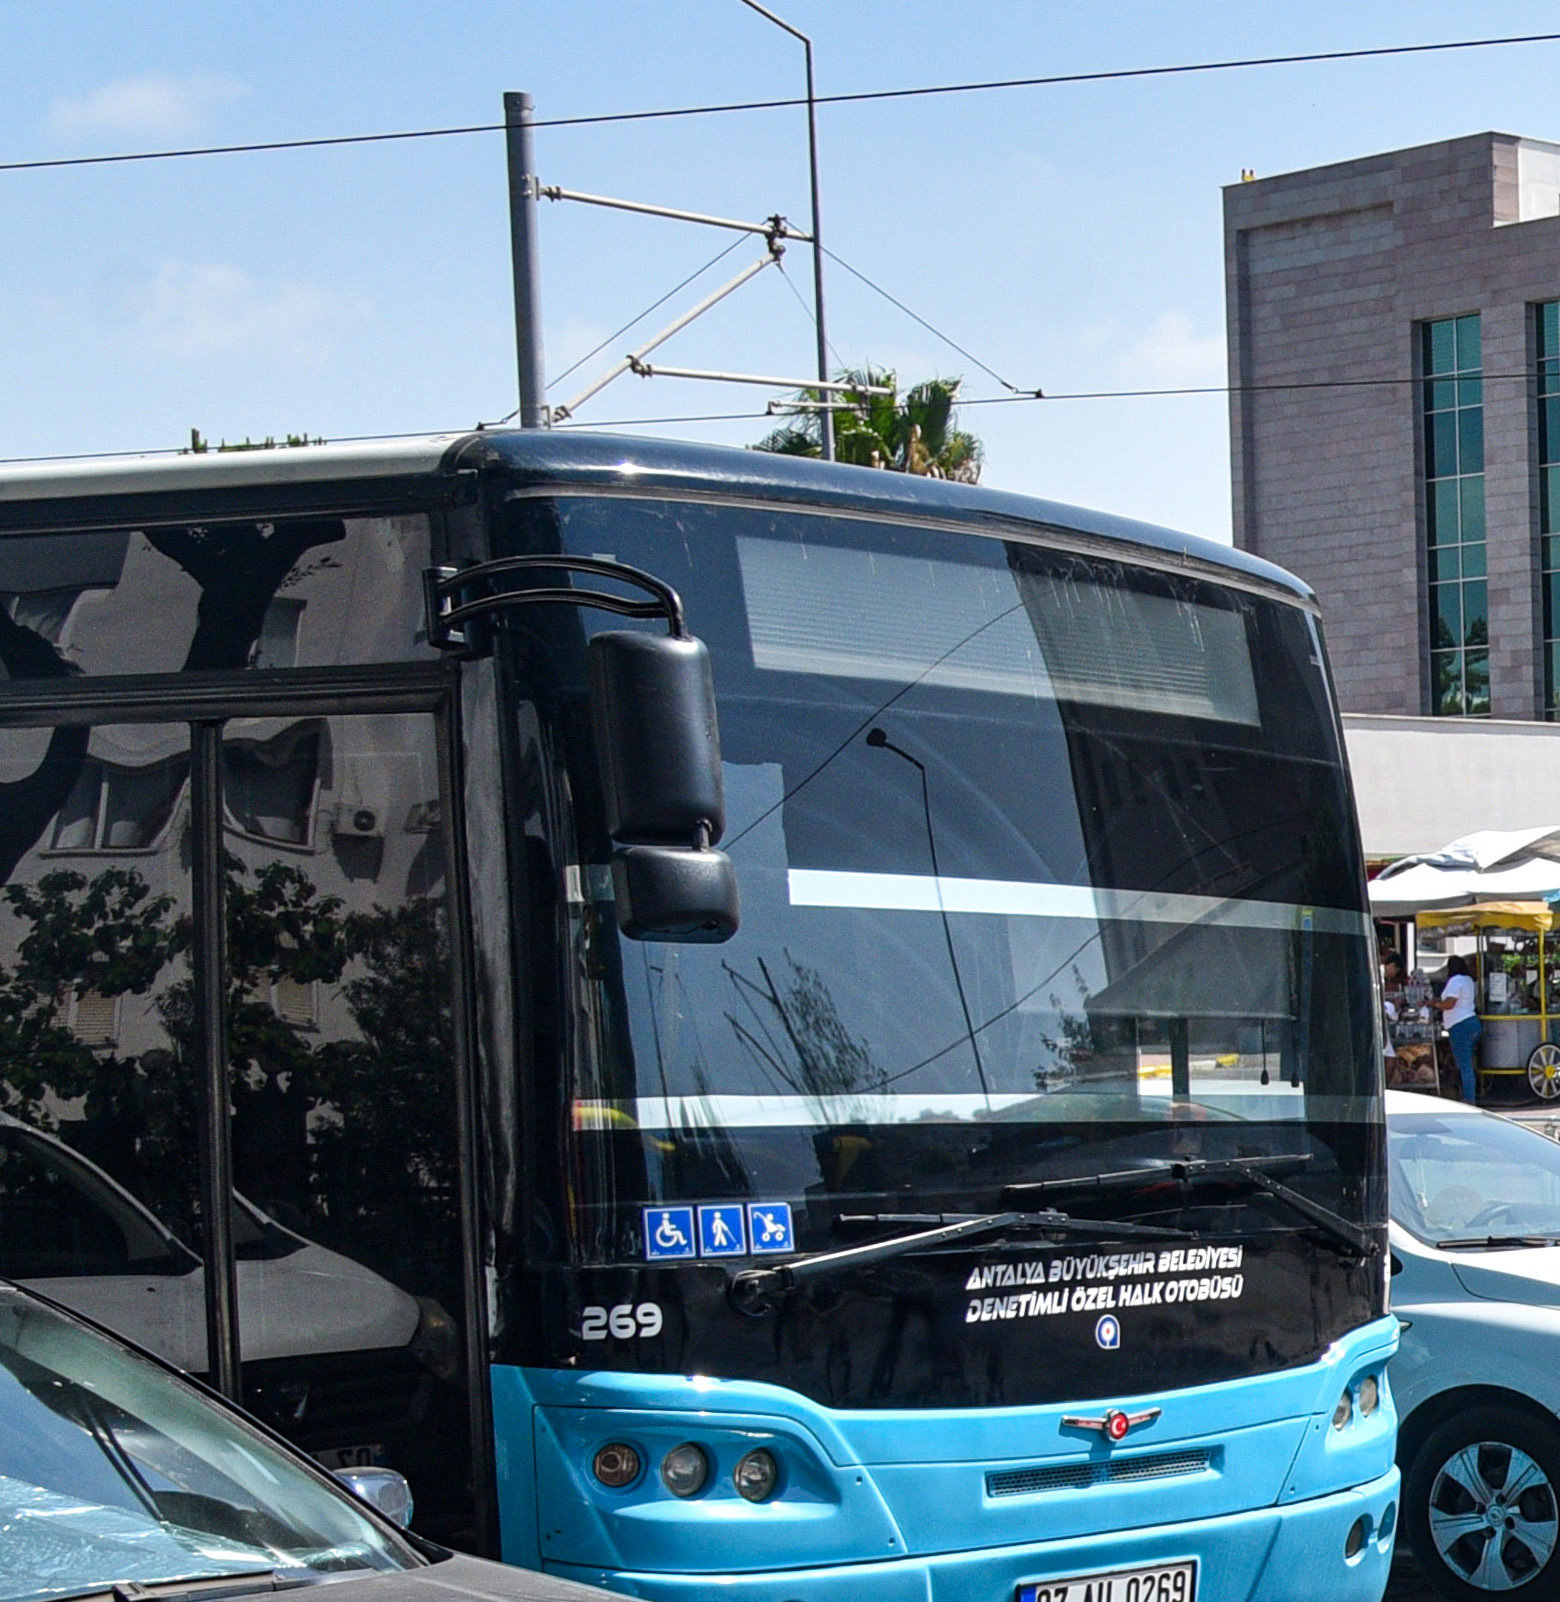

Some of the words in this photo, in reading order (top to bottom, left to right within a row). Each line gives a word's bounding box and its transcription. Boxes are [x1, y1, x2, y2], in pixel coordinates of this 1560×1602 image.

[965, 1260, 1046, 1291] ANTALYA
[1049, 1251, 1156, 1283] BÜYÜKŞEHİR
[1157, 1244, 1243, 1273] BELEDİYESİ
[582, 1301, 664, 1341] 269
[965, 1287, 1069, 1324] DENETİMLİ
[1071, 1286, 1117, 1313] ÖZEL
[1118, 1282, 1164, 1308] HALK
[1164, 1274, 1244, 1304] OTOBÜSÜ
